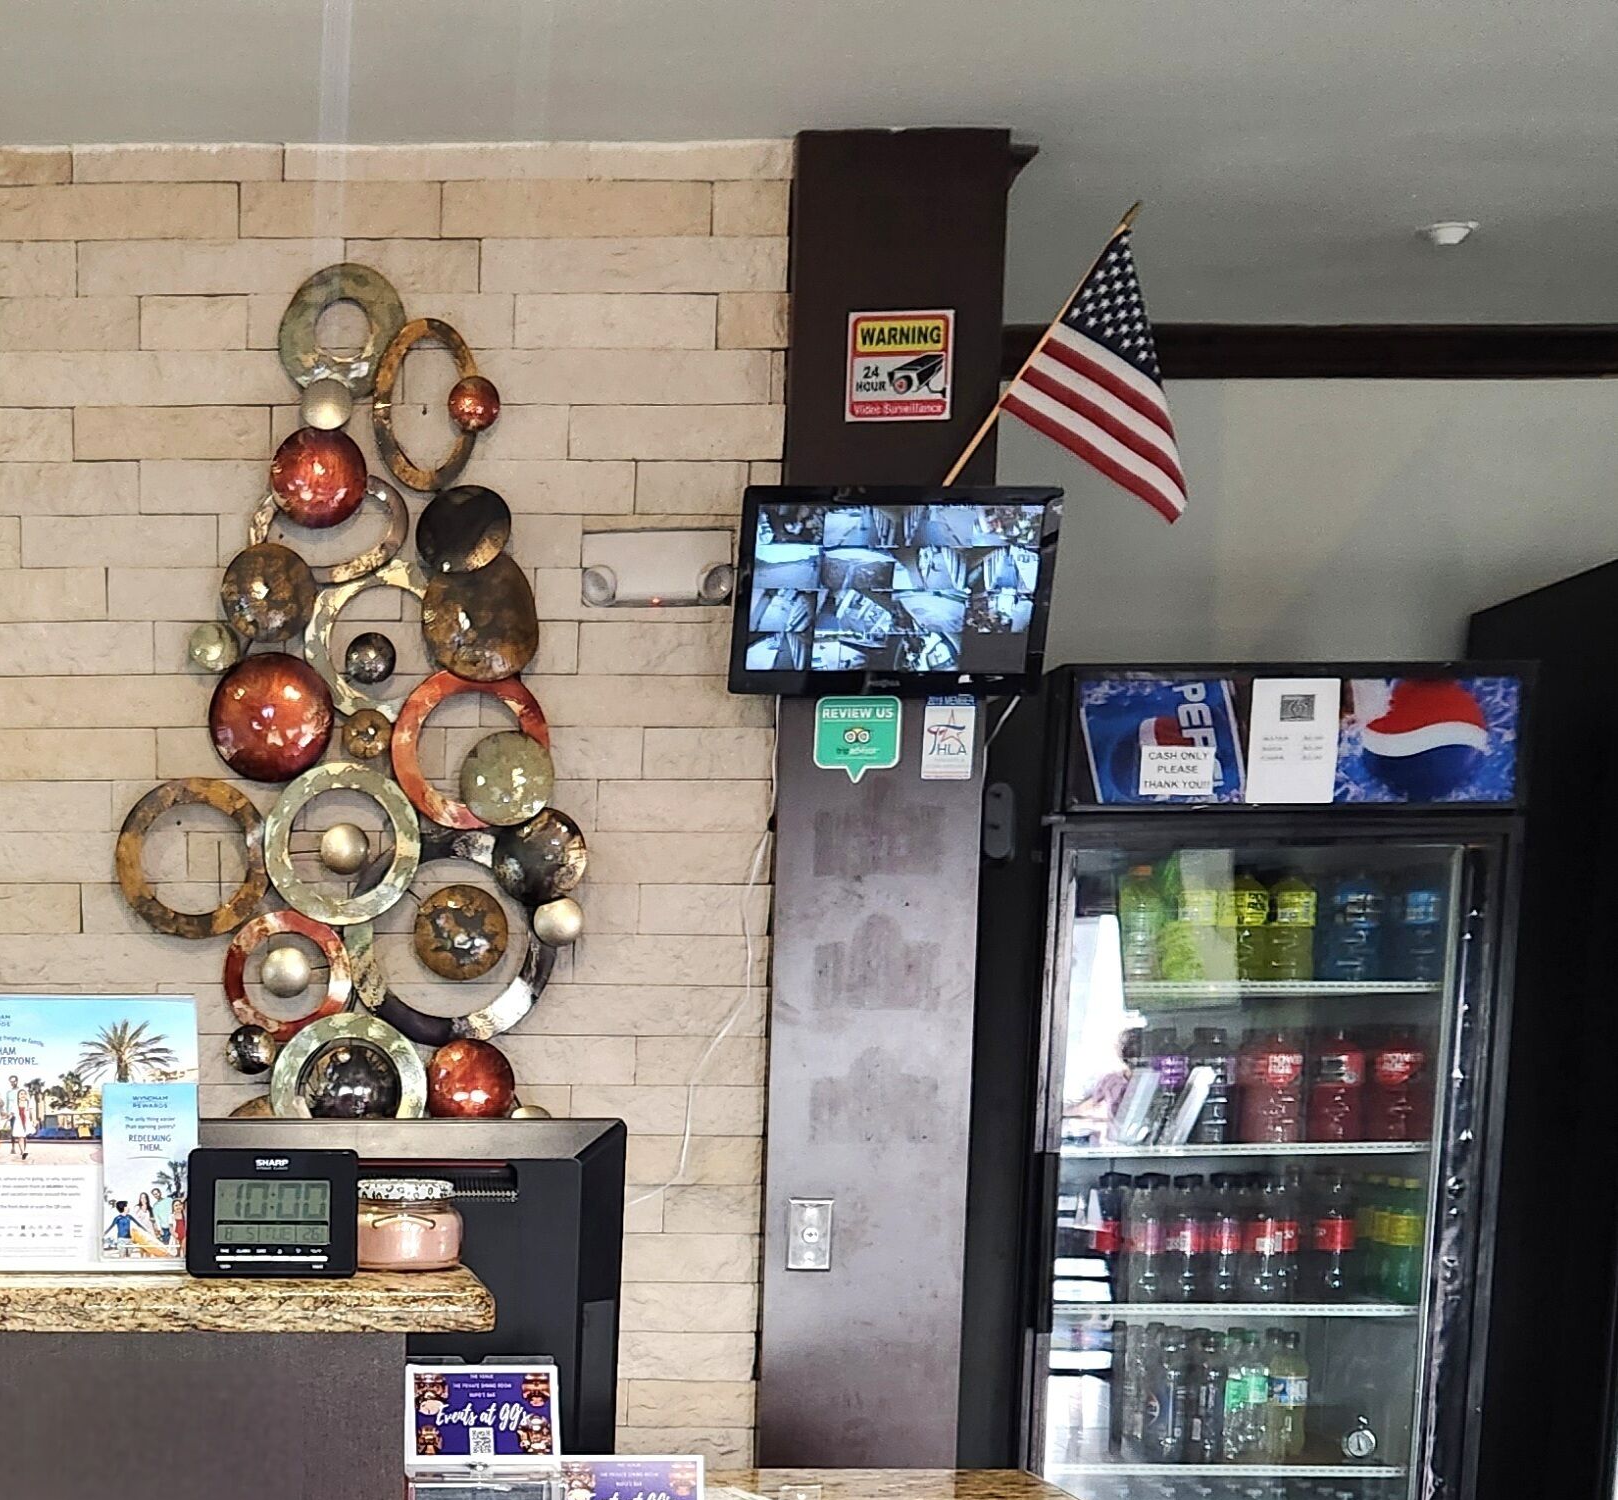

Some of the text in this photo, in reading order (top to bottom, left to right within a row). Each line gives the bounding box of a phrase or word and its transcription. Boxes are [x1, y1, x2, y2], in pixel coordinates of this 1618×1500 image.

[860, 326, 942, 346] WARNING
[863, 365, 880, 379] 24
[855, 381, 887, 392] HOUR
[854, 402, 943, 416] Video Surveillance
[822, 708, 894, 719] REVIEW US
[1148, 751, 1208, 760] CASH ONLY
[1157, 765, 1198, 774] PLEASE
[1144, 780, 1179, 789] THANK
[128, 1134, 171, 1142] REDEEMING
[255, 1159, 289, 1167] SHARP
[235, 1183, 328, 1219] 10:00
[436, 1404, 477, 1426] Events
[479, 1402, 496, 1425] at
